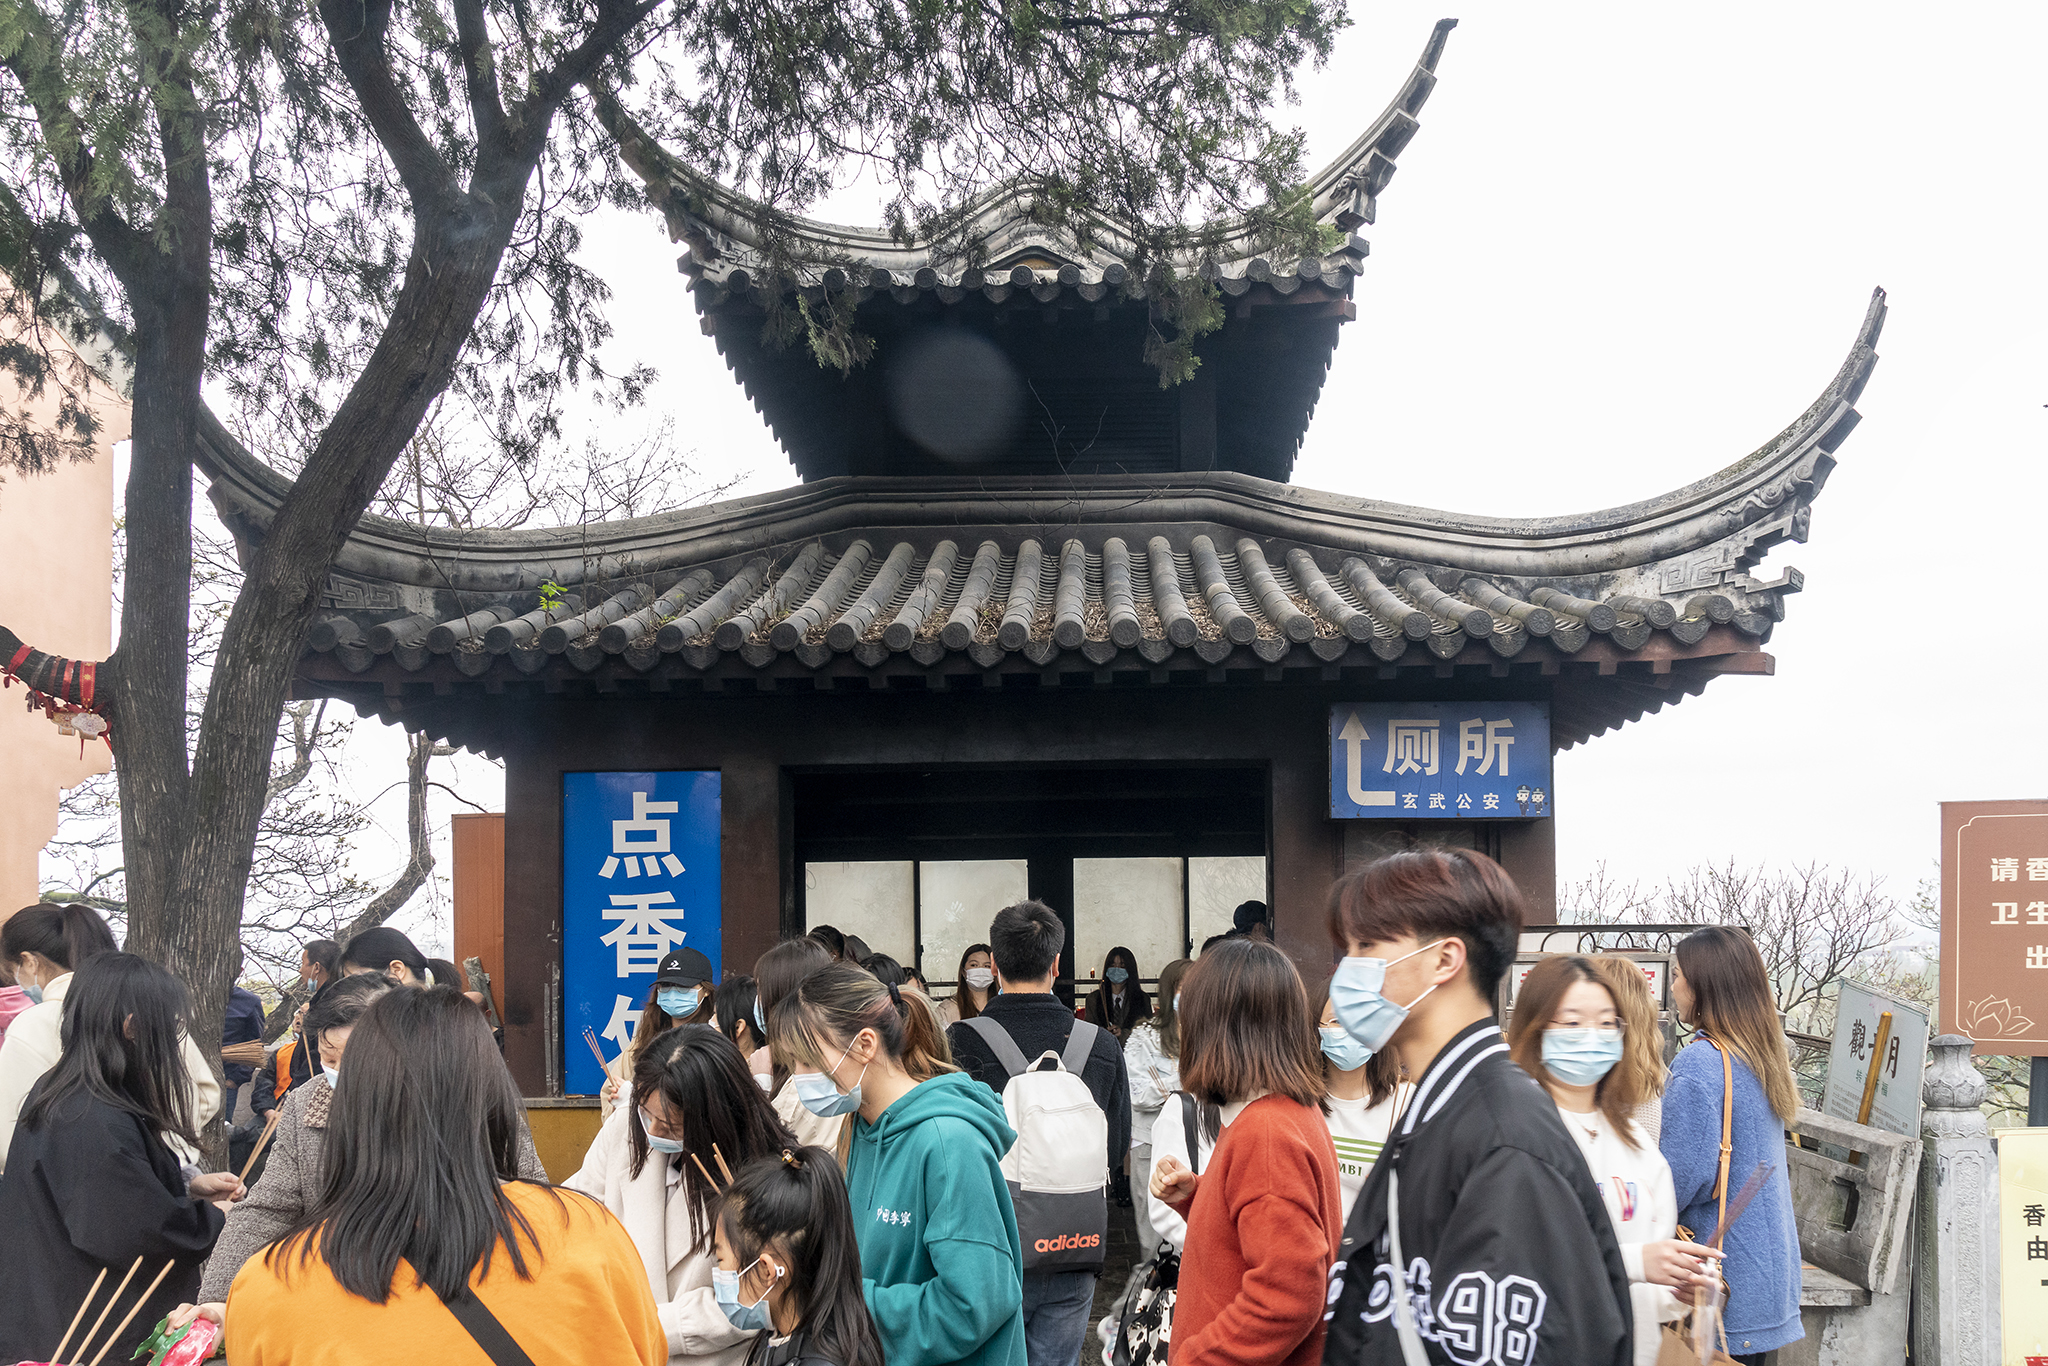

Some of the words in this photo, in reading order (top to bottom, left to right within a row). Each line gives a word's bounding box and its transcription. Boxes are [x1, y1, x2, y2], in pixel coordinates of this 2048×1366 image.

[1382, 717, 1515, 777] 厕所
[1401, 792, 1500, 810] 玄武公安
[1990, 857, 2048, 882] 请香
[1990, 901, 2048, 925] 卫生
[1848, 1018, 1900, 1079] 觀月
[1034, 1232, 1100, 1253] adidas
[1437, 1270, 1547, 1366] 98
